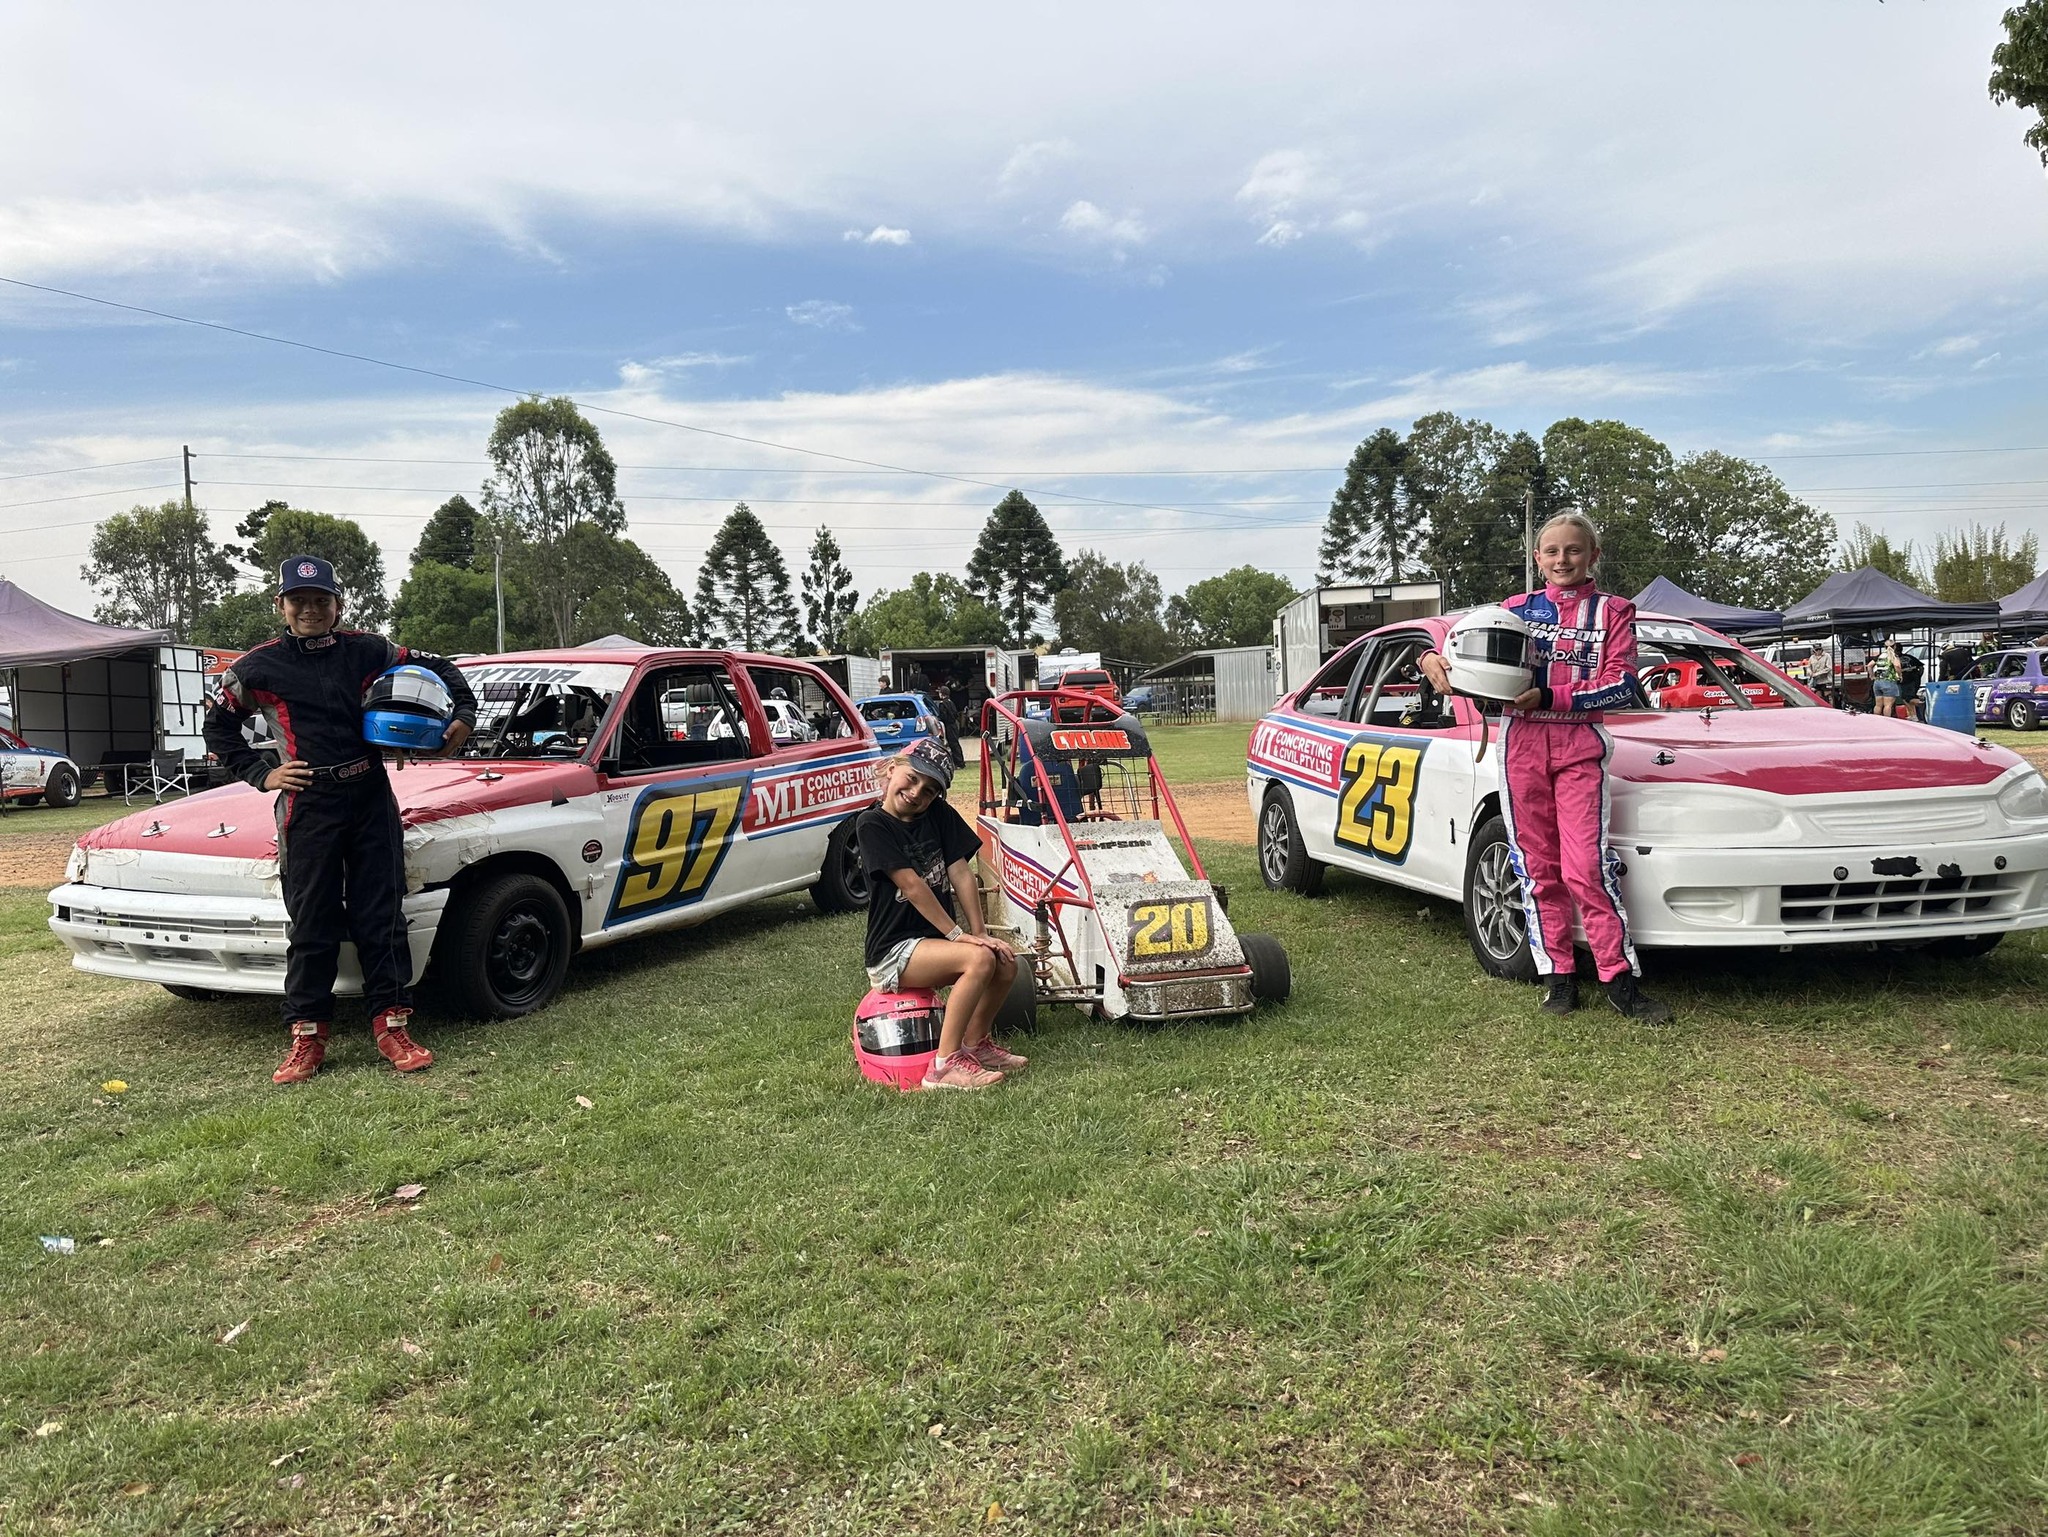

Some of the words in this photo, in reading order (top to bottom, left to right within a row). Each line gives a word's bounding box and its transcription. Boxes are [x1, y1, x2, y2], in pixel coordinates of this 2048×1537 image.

[463, 668, 582, 682] AYTONA
[1583, 688, 1632, 709] GUMDALE
[1530, 710, 1589, 720] MONTOYA
[1051, 730, 1131, 750] CYCLONE
[1276, 731, 1333, 761] CONCRETING
[1273, 745, 1278, 756] &
[1279, 748, 1298, 764] CIVIL
[1300, 754, 1316, 769] PTY
[1316, 759, 1332, 775] LTD
[752, 778, 804, 826] MI
[808, 793, 815, 806] &
[817, 788, 843, 803] CIVIL
[845, 782, 862, 797] PTY
[864, 779, 880, 794] LTD
[1338, 742, 1421, 855] 23
[619, 786, 741, 908] 97
[1076, 840, 1152, 850] SIMPSON
[1004, 856, 1049, 893] CONCRETIN
[1134, 901, 1208, 956] 20
[887, 1010, 930, 1019] Mercury
